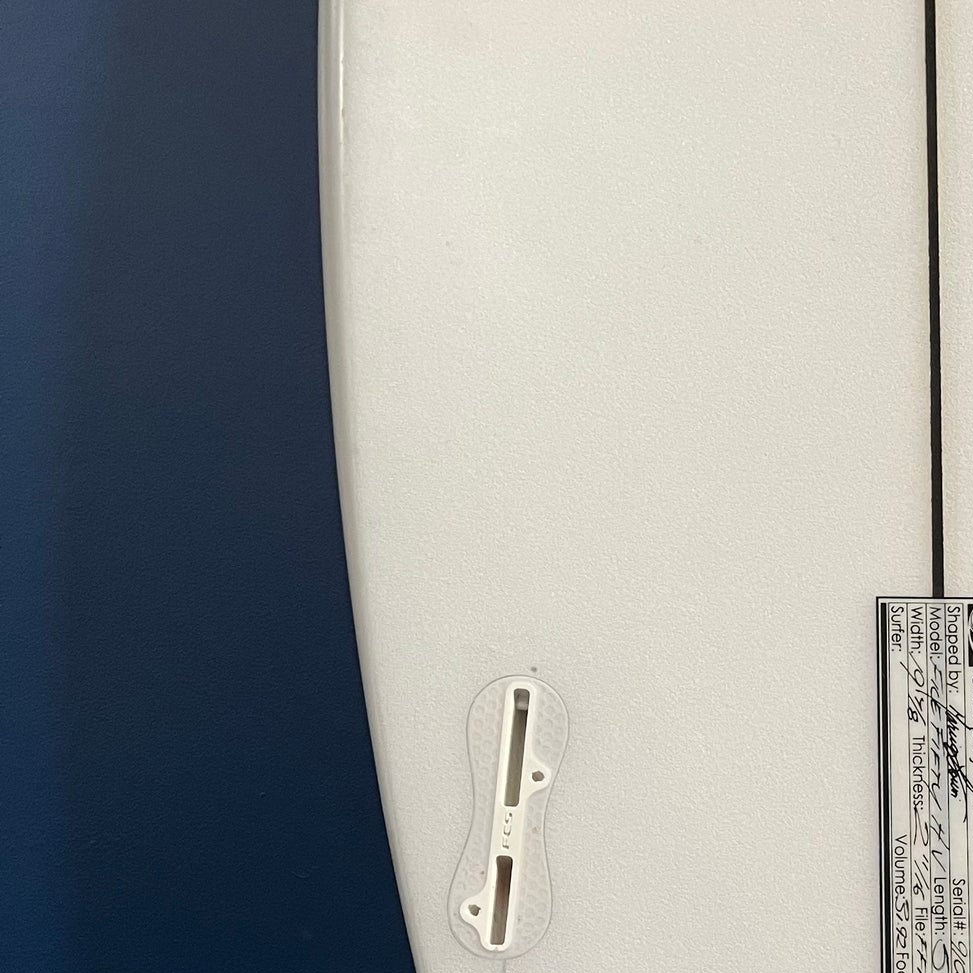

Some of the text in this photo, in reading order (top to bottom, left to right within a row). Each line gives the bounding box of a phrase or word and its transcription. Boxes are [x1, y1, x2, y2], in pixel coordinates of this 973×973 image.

[891, 606, 904, 652] Surfer:
[910, 606, 924, 654] Width:
[930, 606, 942, 660] Model:
[946, 606, 961, 665] Shaped
[946, 670, 962, 693] by:
[912, 736, 926, 810] Thickness:
[895, 835, 908, 898] Volume:
[916, 908, 928, 935] File:
[931, 877, 947, 935] Length:
[953, 879, 966, 935] Serial#:
